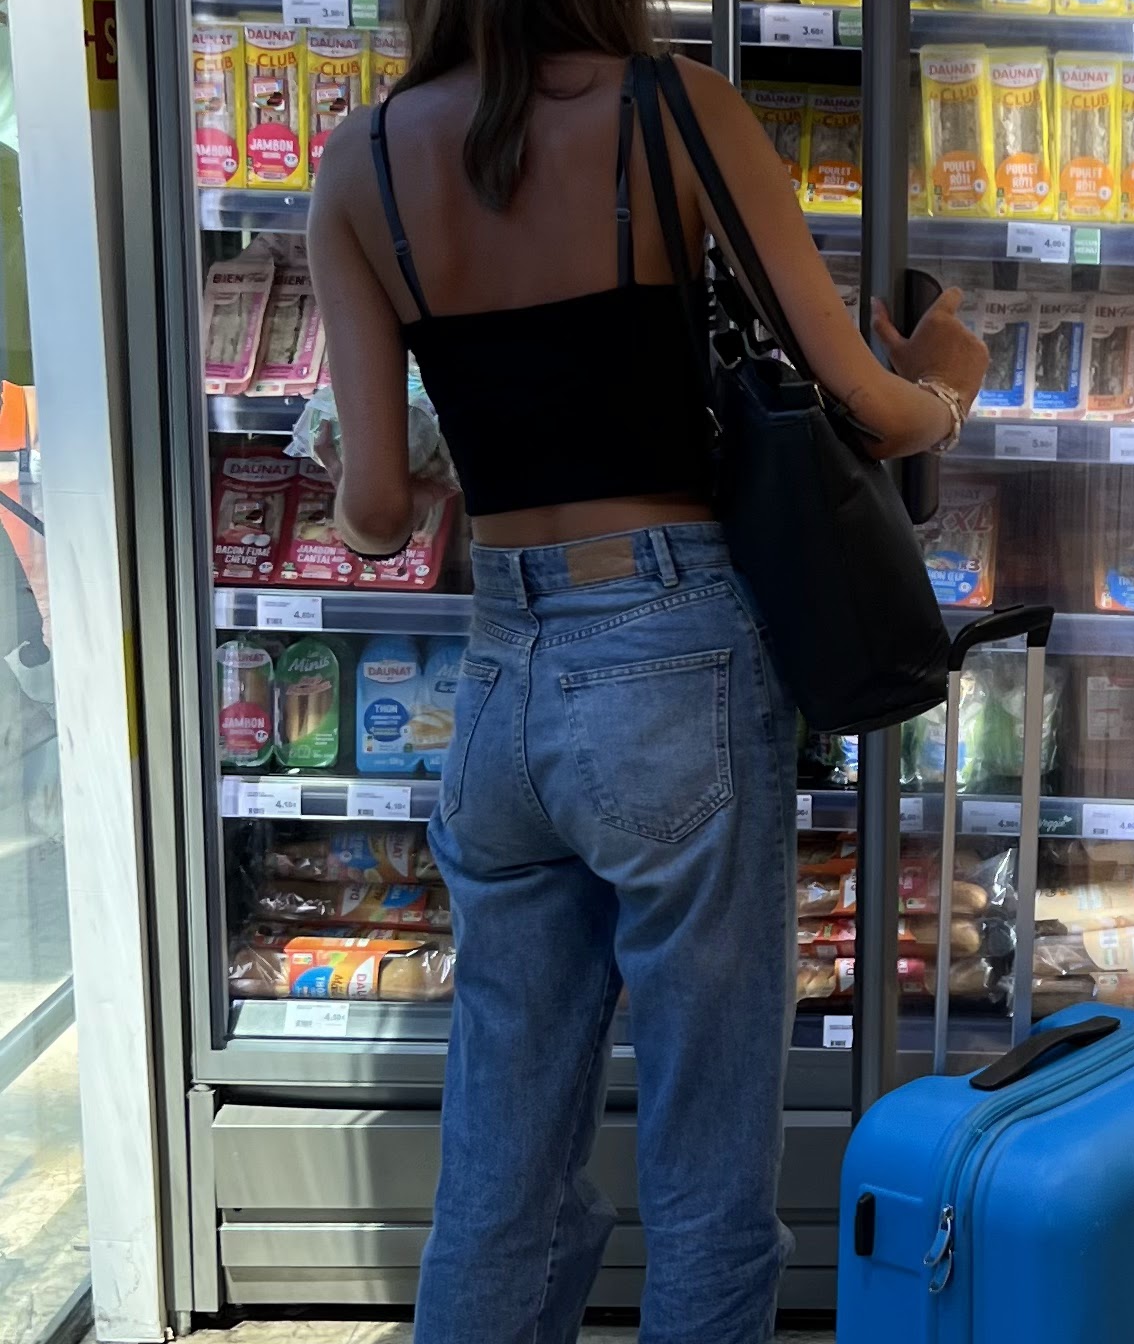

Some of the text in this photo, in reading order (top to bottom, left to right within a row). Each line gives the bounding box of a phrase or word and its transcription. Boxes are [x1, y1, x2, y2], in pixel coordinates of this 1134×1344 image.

[192, 34, 232, 47] AUNAT
[247, 27, 296, 42] DAUNAT
[310, 37, 359, 50] DAUNAT
[257, 51, 297, 69] CLUB
[320, 61, 360, 76] CLUB
[929, 64, 976, 76] DAUNAT
[993, 68, 1041, 80] DAUNAT
[1063, 71, 1109, 83] DAUNAT
[940, 85, 978, 102] CLUB
[1003, 90, 1041, 106] CLUB
[1072, 93, 1109, 109] CLUB
[250, 138, 294, 152] JAMBON
[943, 160, 976, 172] POULET
[1006, 162, 1038, 174] POULET
[1069, 167, 1103, 178] POULET
[230, 463, 290, 475] DAUNAT
[296, 545, 337, 556] JAMBON
[297, 554, 331, 565] CANTAL
[368, 666, 413, 677] DAUNAT
[222, 717, 266, 729] JAMBON
